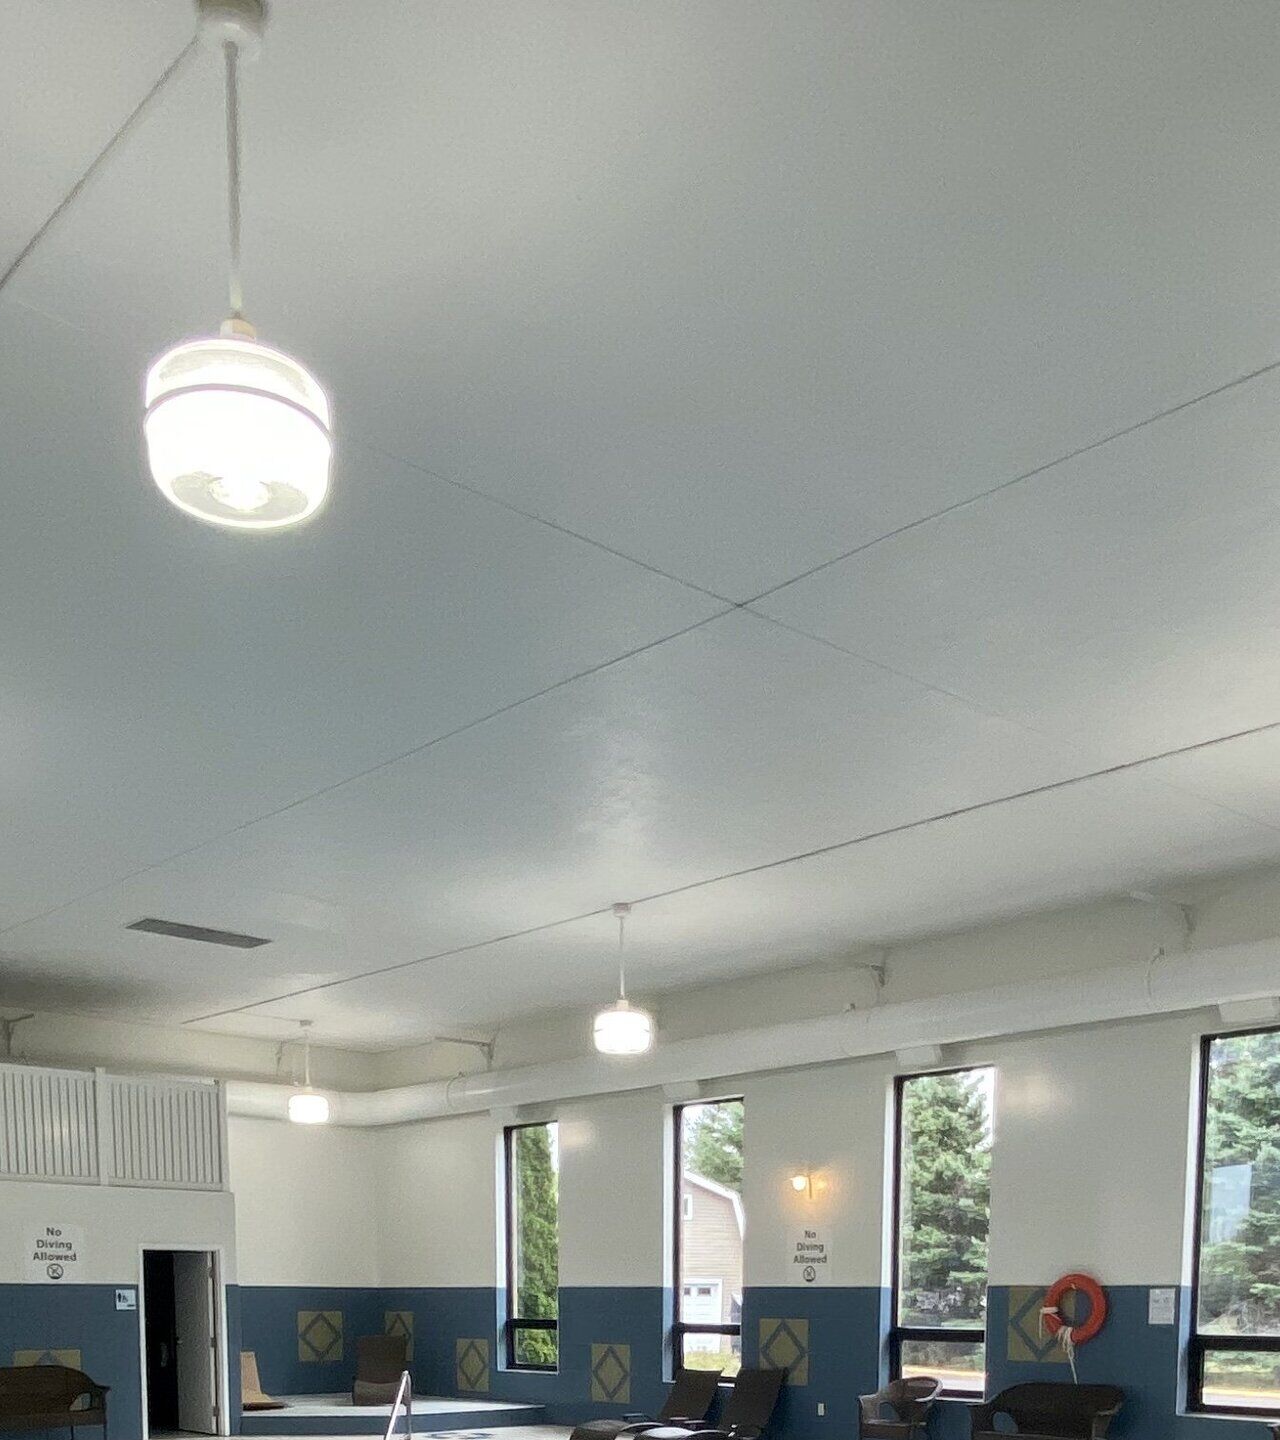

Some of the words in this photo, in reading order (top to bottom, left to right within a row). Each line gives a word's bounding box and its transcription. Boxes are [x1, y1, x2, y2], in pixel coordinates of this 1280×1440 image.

[46, 1227, 62, 1236] No
[804, 1230, 817, 1239] No
[36, 1239, 72, 1251] Diving
[796, 1242, 824, 1253] Diving
[33, 1252, 77, 1261] Allowed
[793, 1254, 827, 1264] Allowed
